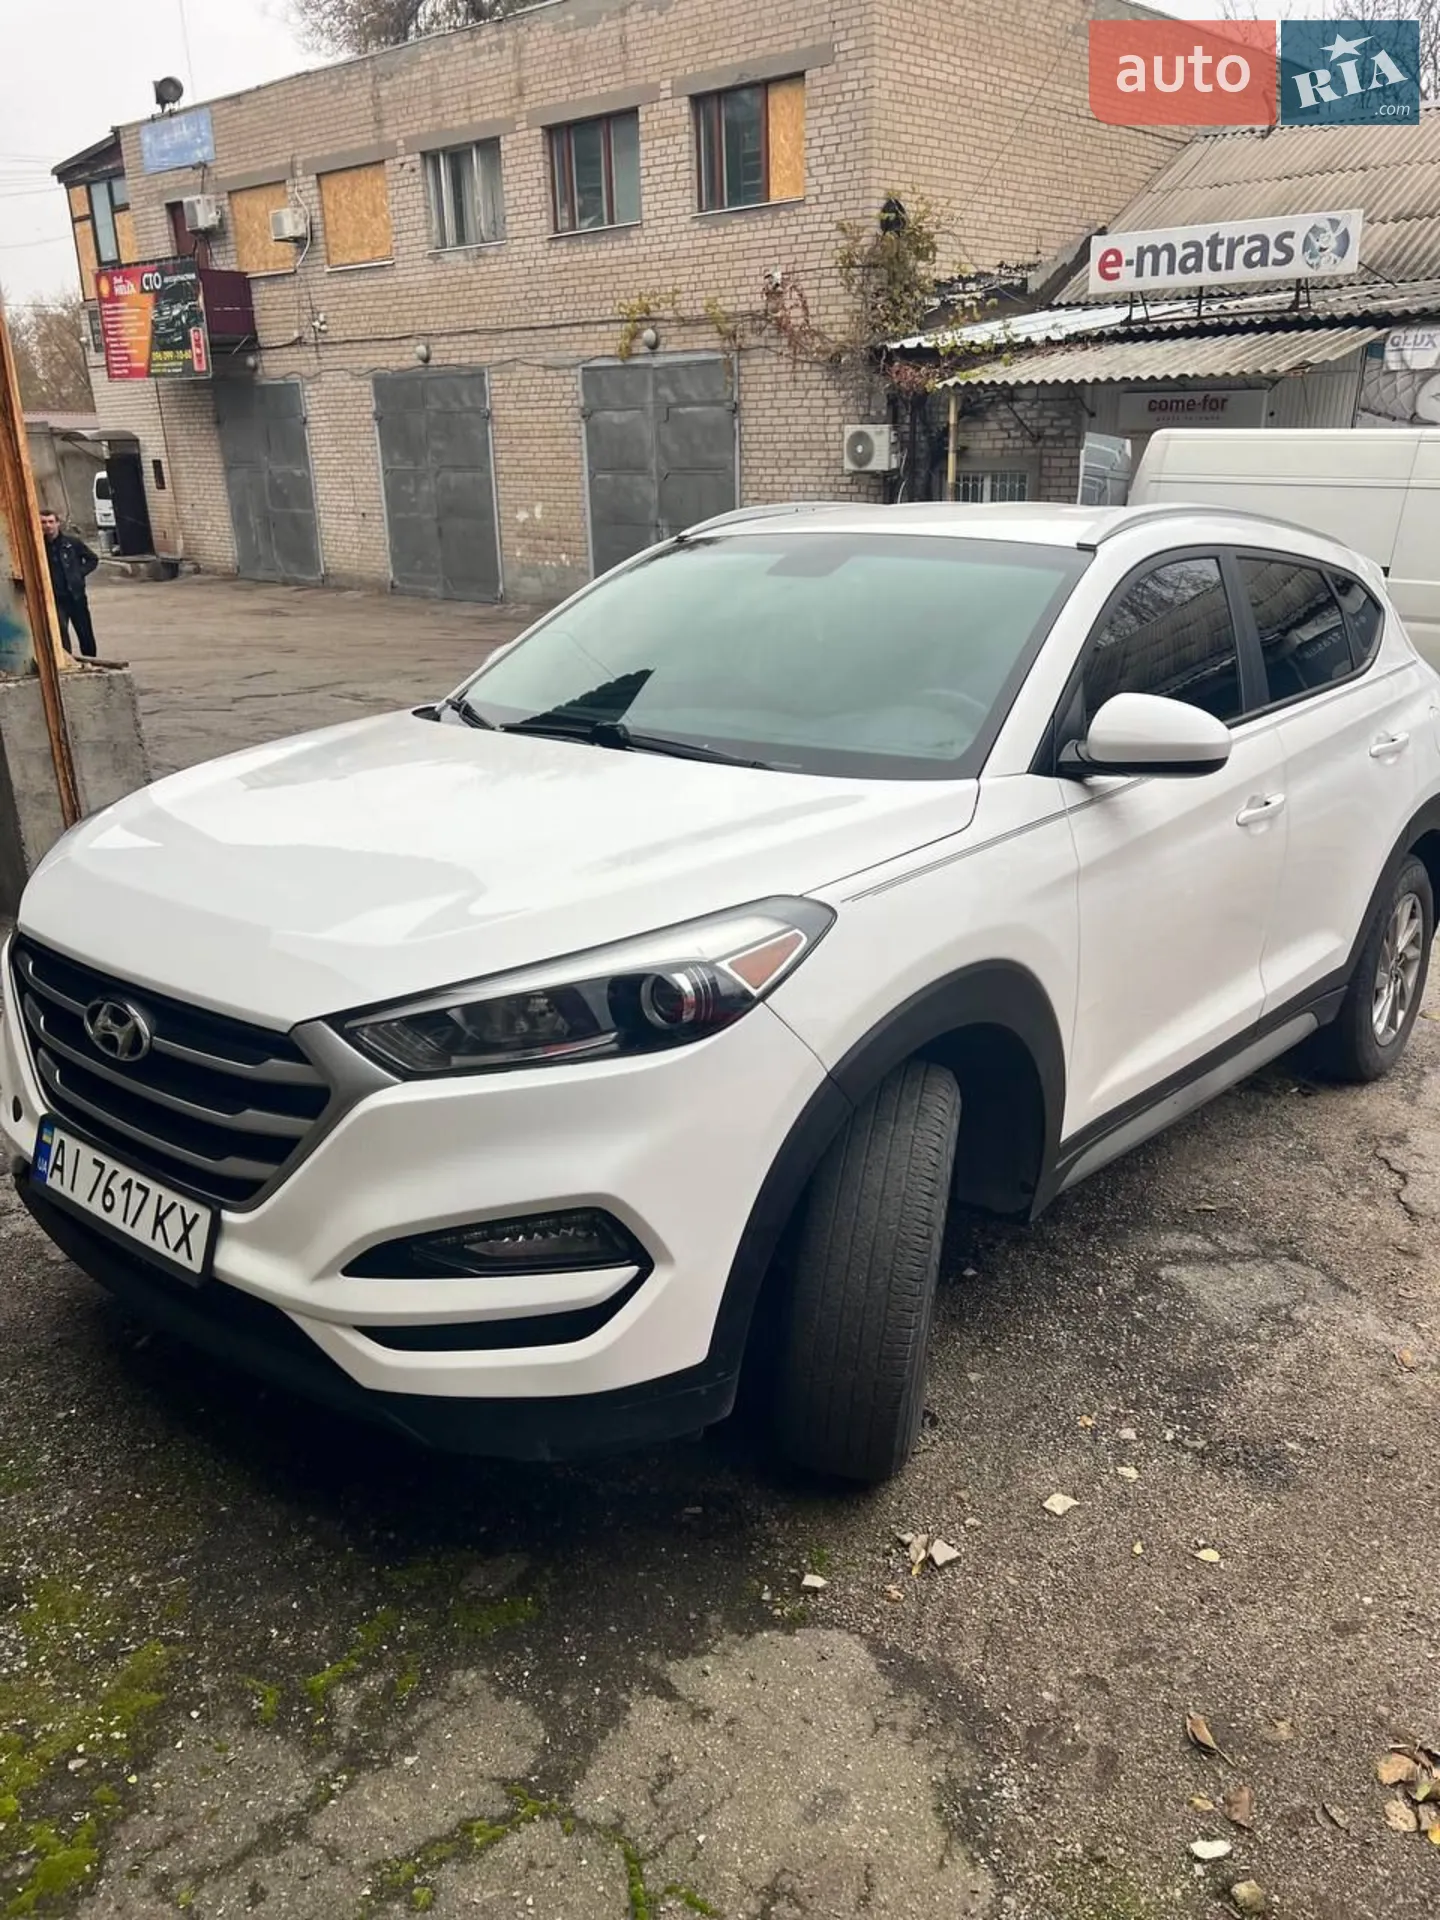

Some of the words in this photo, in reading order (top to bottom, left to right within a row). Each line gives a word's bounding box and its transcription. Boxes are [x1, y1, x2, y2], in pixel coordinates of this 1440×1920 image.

[1097, 229, 1295, 282] e-matras
[37, 1156, 48, 1173] UA
[49, 1138, 79, 1193] AI
[87, 1158, 152, 1229] 7617
[150, 1194, 201, 1262] KX
